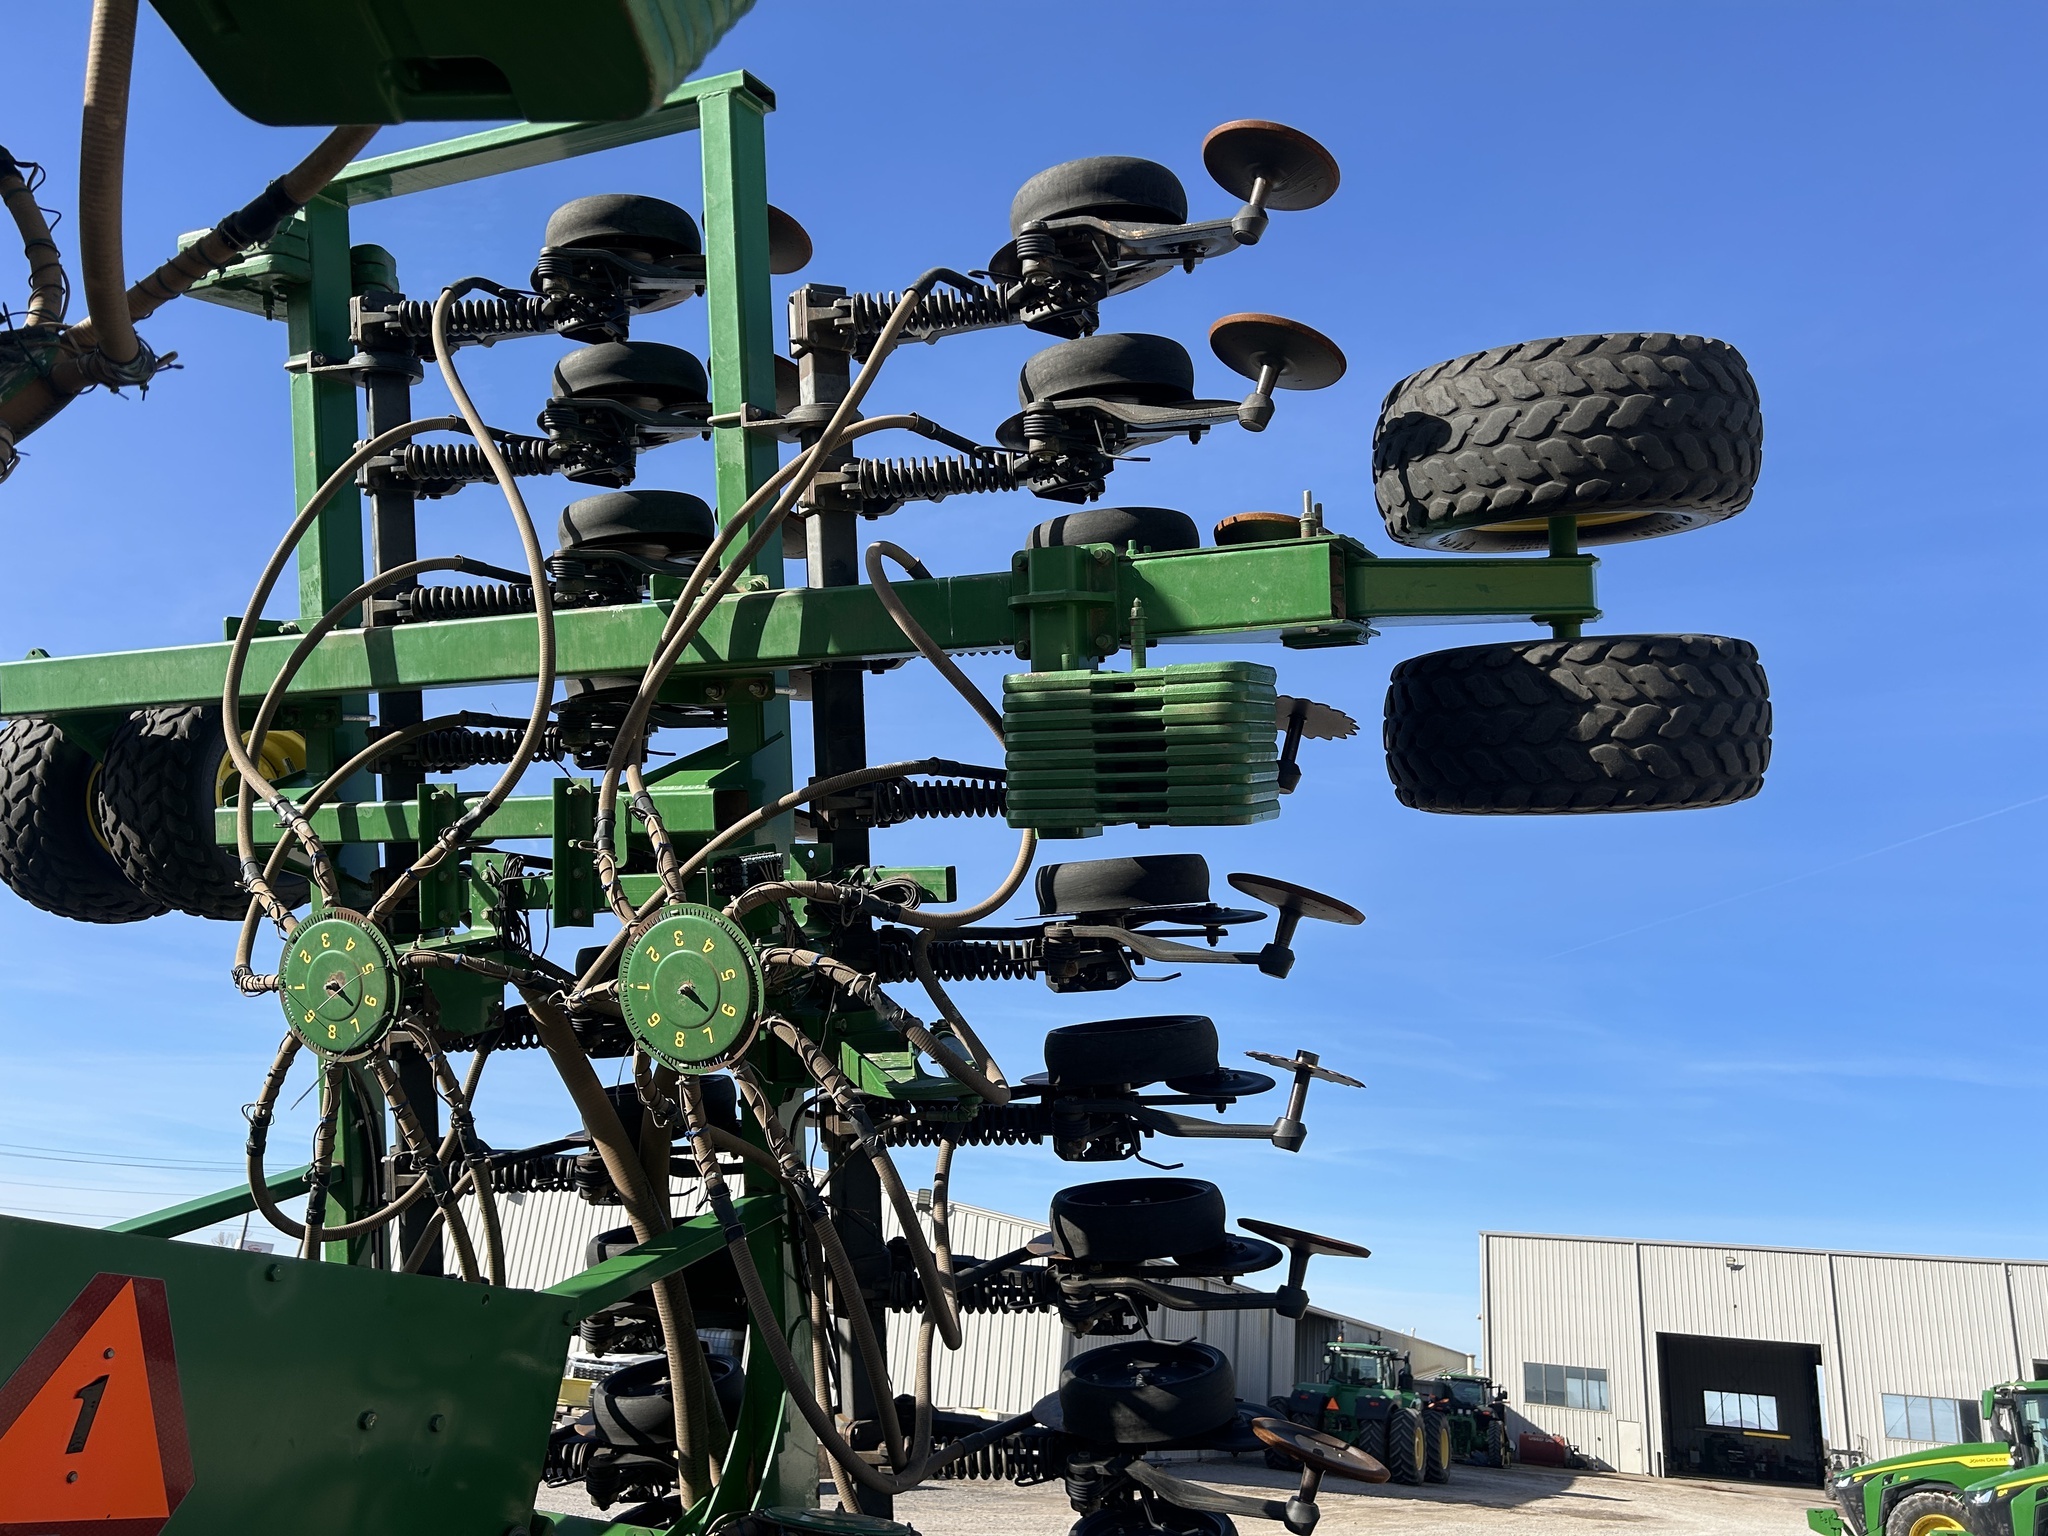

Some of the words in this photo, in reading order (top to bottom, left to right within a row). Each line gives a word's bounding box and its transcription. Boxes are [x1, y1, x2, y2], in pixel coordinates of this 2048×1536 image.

[321, 932, 331, 948] 3
[345, 937, 356, 952] 4
[673, 930, 684, 947] 3
[702, 937, 715, 954] 4
[299, 949, 312, 964] 2
[646, 945, 660, 963] 2
[361, 962, 375, 976] 5
[720, 968, 736, 982] 5
[294, 983, 306, 991] 1
[636, 982, 651, 991] 1
[364, 994, 377, 1007] 6
[304, 1009, 316, 1024] 9
[721, 1003, 737, 1018] 6
[350, 1017, 361, 1033] 7
[647, 1012, 661, 1028] 9
[328, 1024, 337, 1040] 8
[674, 1031, 685, 1048] 8
[702, 1026, 714, 1044] 7
[65, 1374, 110, 1454] 1
